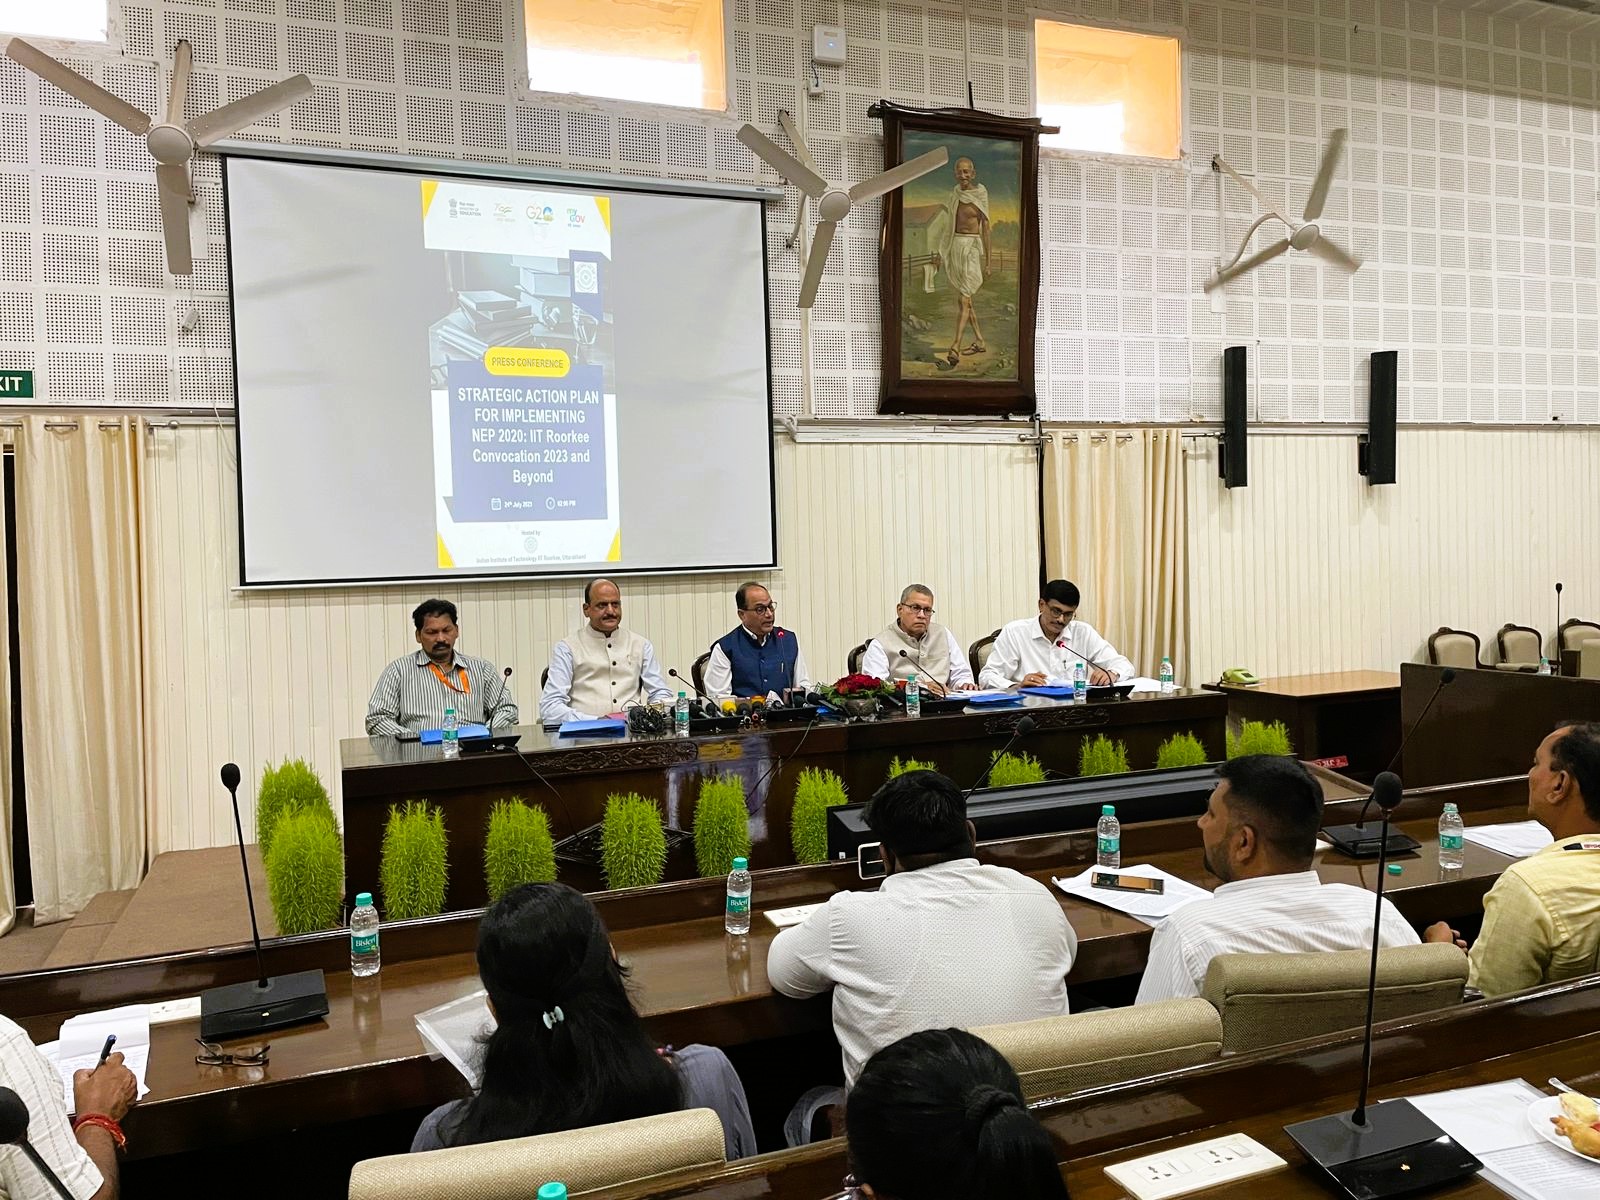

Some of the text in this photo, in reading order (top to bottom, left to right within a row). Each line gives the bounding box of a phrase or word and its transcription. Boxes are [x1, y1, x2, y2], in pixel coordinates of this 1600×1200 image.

[526, 206, 554, 222] G20
[492, 357, 564, 369] PRESS CONFERENCE
[458, 388, 599, 404] STRATEGIC ACTION PLAN
[474, 408, 585, 423] FOR IMPLEMENTING
[472, 428, 590, 443] NEP 2020: IIT Roorkee
[473, 449, 590, 462] Convocation 2023 and
[513, 470, 554, 486] Beyond
[356, 936, 375, 946] Bisleri
